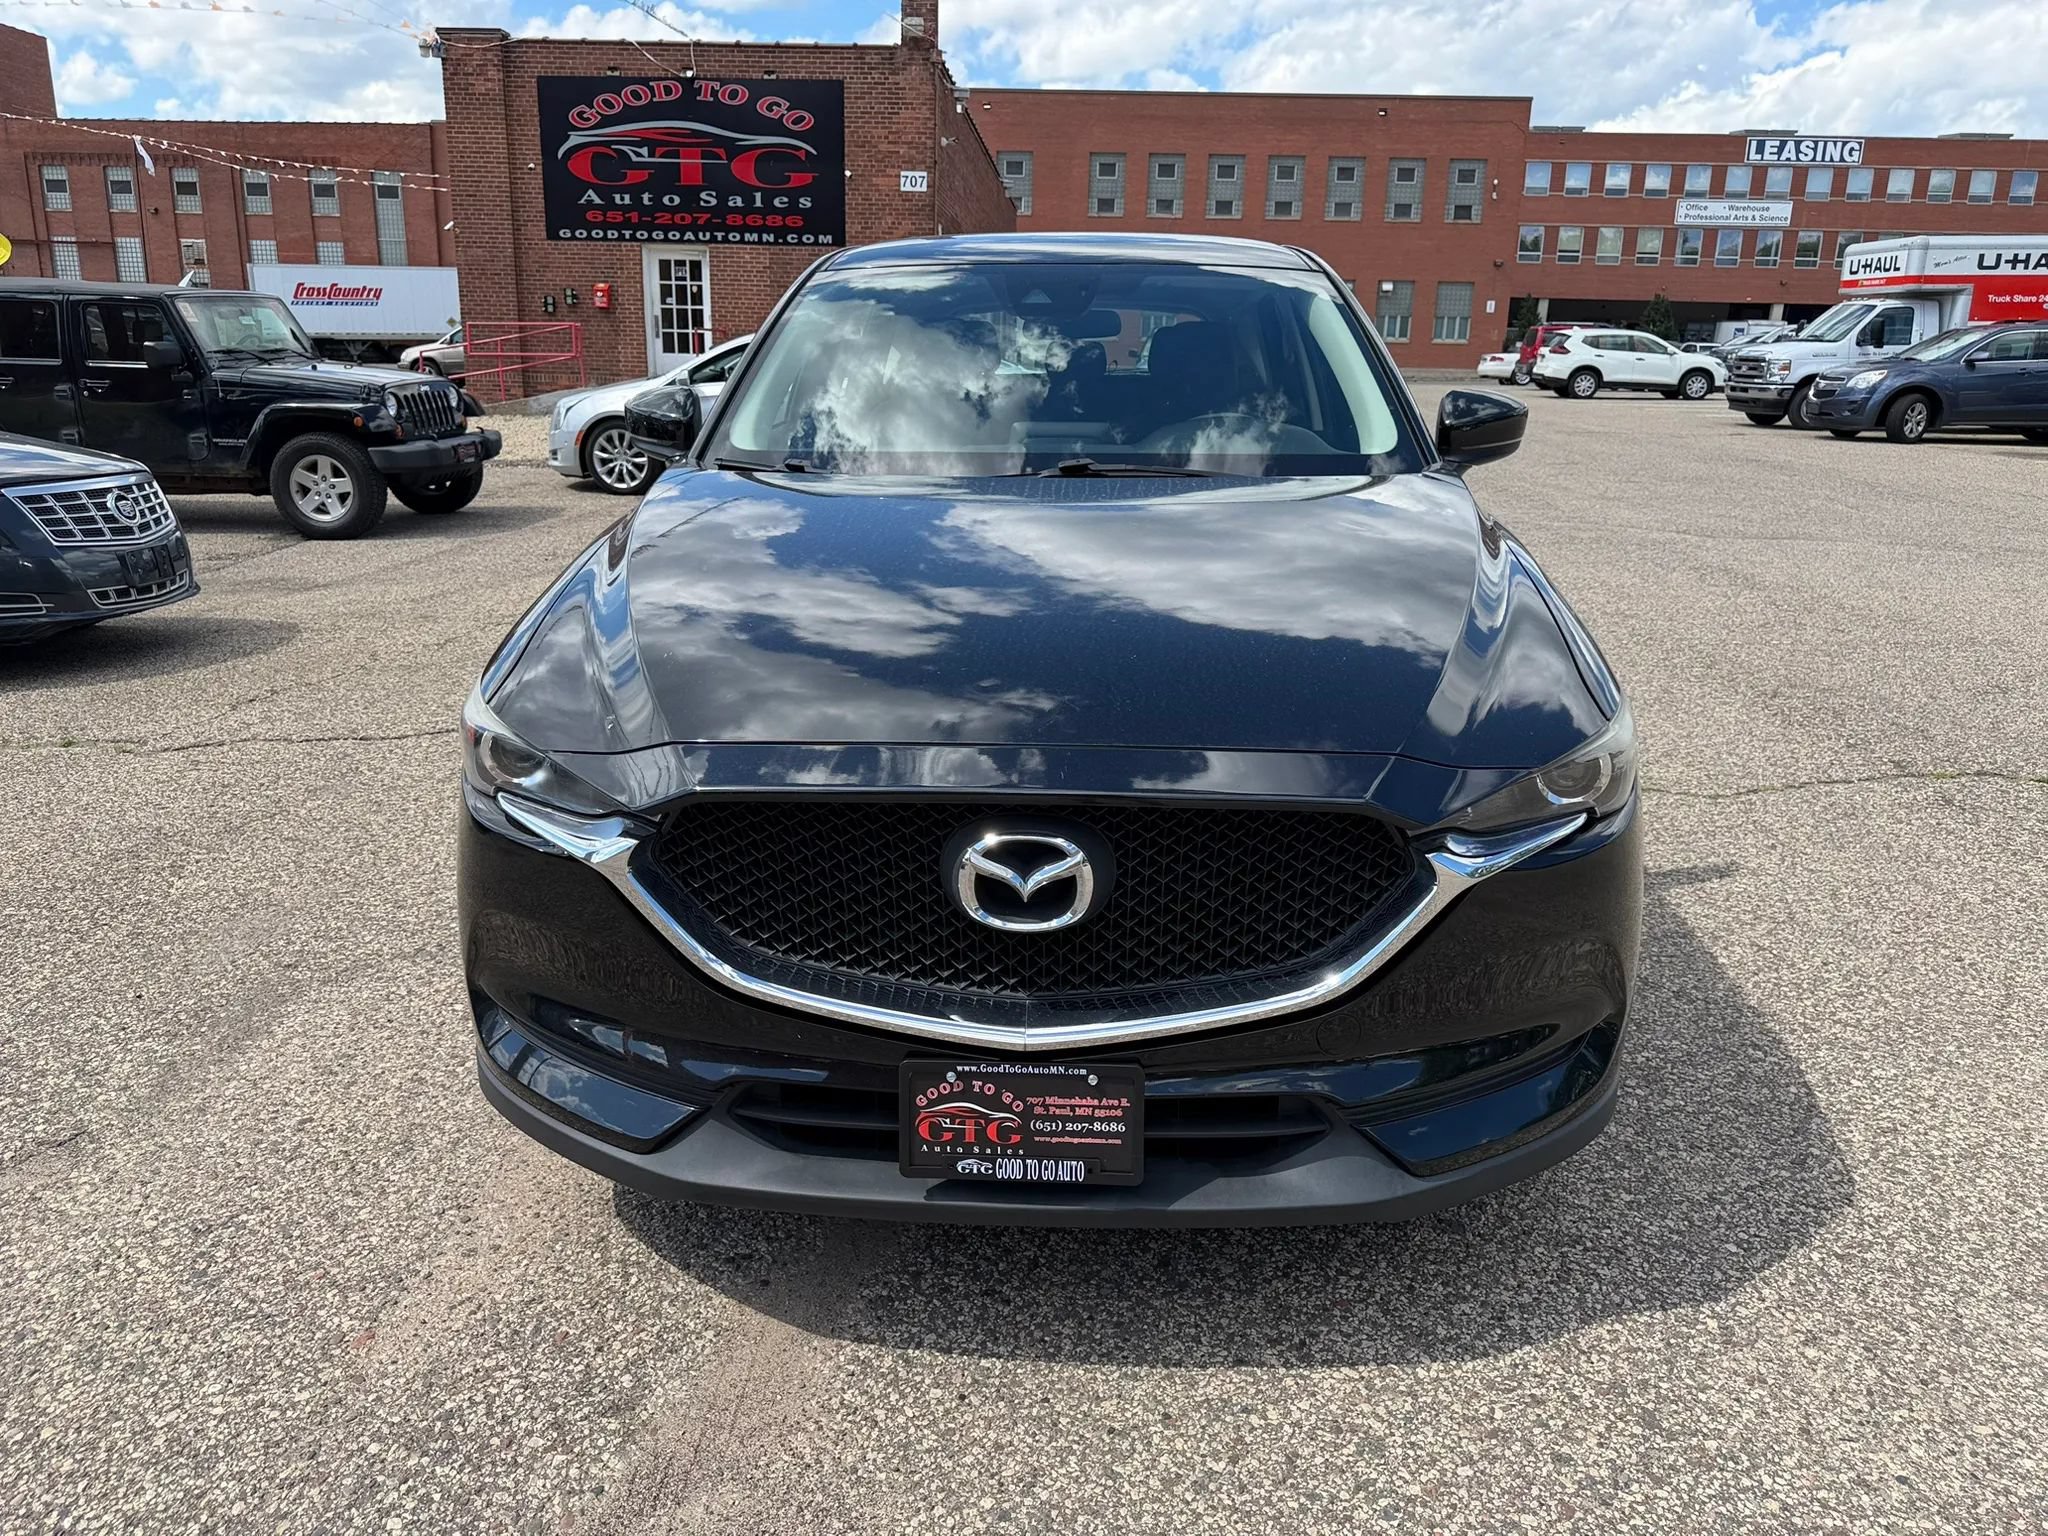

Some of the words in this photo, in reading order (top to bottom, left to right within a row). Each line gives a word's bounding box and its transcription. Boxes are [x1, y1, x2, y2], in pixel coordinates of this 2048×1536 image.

[568, 80, 682, 128] GOOD
[694, 80, 749, 105] TO
[756, 96, 815, 131] GO
[1748, 140, 1861, 163] LEASING
[567, 146, 820, 188] GTG
[902, 175, 926, 188] 707
[577, 189, 681, 207] Auto
[699, 190, 812, 209] Sales
[1685, 203, 1709, 211] Office
[1727, 204, 1770, 212] Warehouse
[585, 210, 805, 228] 651-207-8686
[1683, 213, 1731, 221] Professional
[1750, 214, 1757, 222] &
[1758, 214, 1789, 222] Science
[559, 228, 833, 245] GOODTOGOAUTOMN.COM
[1849, 255, 1901, 275] U-HAUL
[293, 282, 383, 300] CrossCountry
[1987, 294, 2011, 303] Truck
[2012, 294, 2038, 303] Share
[956, 1063, 1087, 1075] www.GoodToGoAutoMN.com
[915, 1080, 964, 1107] GOOD
[972, 1080, 996, 1095] TO
[1001, 1092, 1024, 1112] GO
[1026, 1097, 1044, 1105] 707
[1044, 1096, 1099, 1106] Minnehaha
[1100, 1097, 1119, 1106] Ave
[1120, 1098, 1131, 1106] E.
[1033, 1106, 1047, 1114] St.
[1048, 1106, 1073, 1116] Paul,
[1074, 1107, 1093, 1116] MN
[1094, 1108, 1123, 1117] 55106
[918, 1118, 1024, 1144] GTG
[1030, 1119, 1062, 1132] (651)
[1065, 1121, 1126, 1133] 207-8686
[921, 1144, 963, 1153] Auto
[972, 1145, 1024, 1155] Sales
[957, 1163, 994, 1174] GTG
[996, 1158, 1024, 1179] GOOD
[1026, 1159, 1039, 1180] TO
[1041, 1160, 1055, 1181] GO
[1056, 1161, 1085, 1182] AUTO
